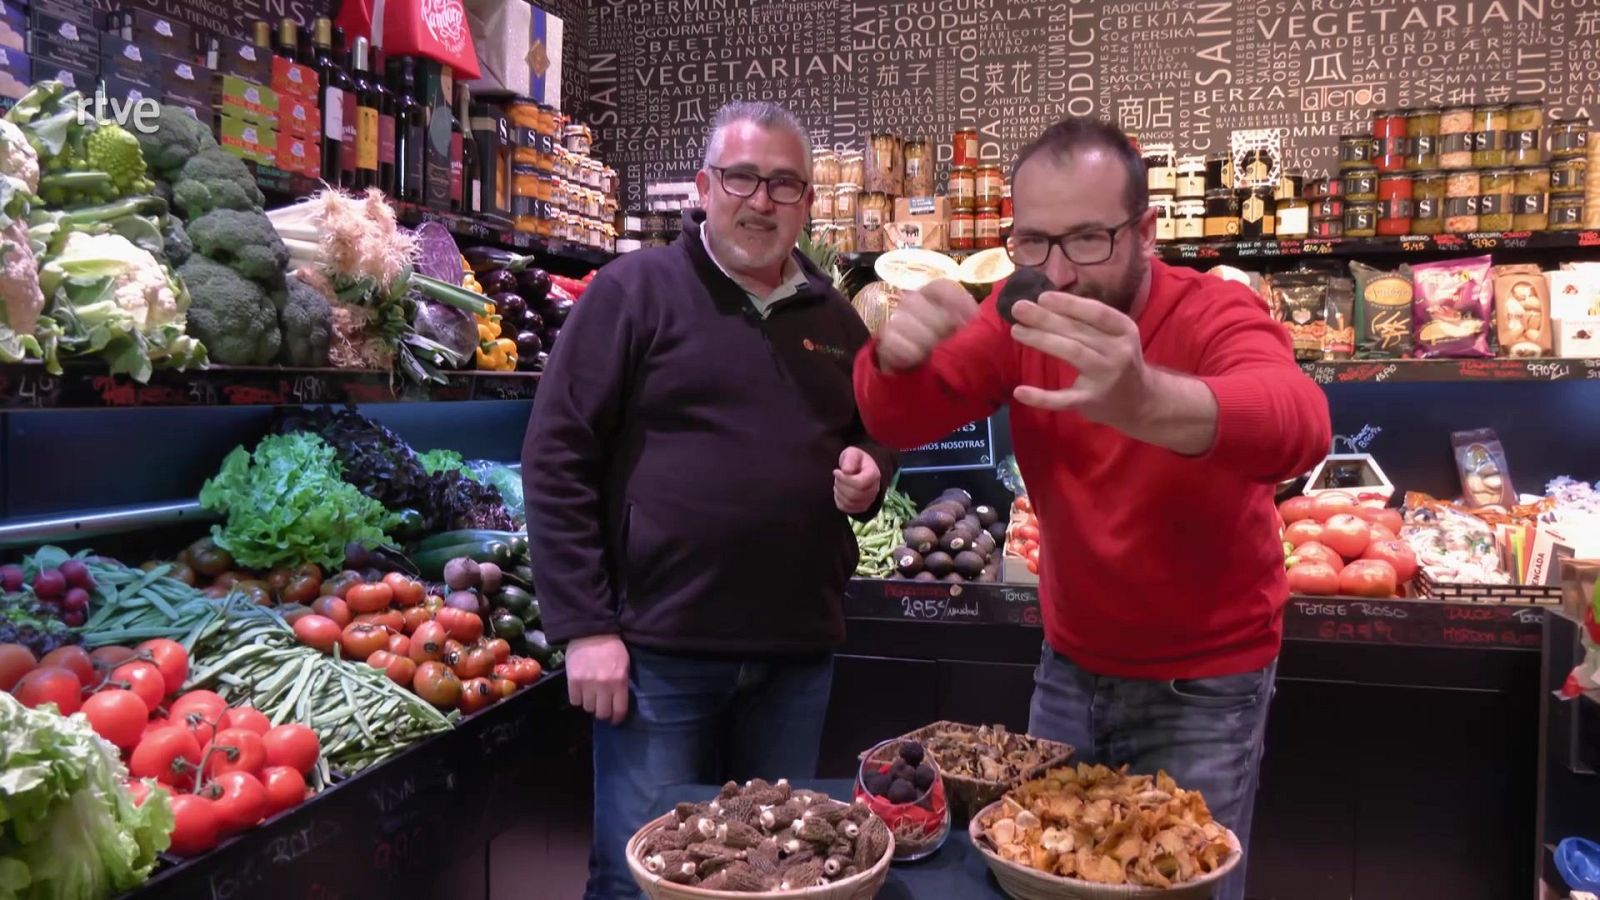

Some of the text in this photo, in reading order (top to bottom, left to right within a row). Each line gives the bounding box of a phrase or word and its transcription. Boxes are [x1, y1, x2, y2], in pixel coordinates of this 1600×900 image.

[670, 7, 761, 23] VERDURE
[789, 0, 840, 13] BRESKVE
[979, 6, 1046, 24] SALAT
[184, 8, 232, 36] TIENDA
[852, 2, 876, 51] EAT
[879, 13, 960, 34] FOOD
[1257, 0, 1545, 40] VEGETARIAN
[645, 21, 724, 39] GOURMET
[877, 29, 961, 50] GARLIC
[1131, 27, 1196, 42] PERSIKA
[634, 17, 646, 67] OVOCE
[649, 36, 719, 53] BEET
[1194, 2, 1232, 85] SAIN
[1290, 31, 1416, 51] AARDBEIEN
[1367, 38, 1500, 59] JORDBÆR
[1047, 3, 1066, 103] CUCUMBERS
[1109, 31, 1119, 73] ALHO
[1120, 34, 1129, 73] PERA
[1548, 11, 1565, 106] LECHUGAS
[635, 52, 853, 86] VEGETARIAN
[1272, 42, 1287, 82] OBST
[1113, 80, 1177, 93] SALATA
[1446, 70, 1516, 85] MAIZE
[588, 52, 619, 125] SAIN
[661, 81, 757, 99] AARDBEIEN
[719, 87, 820, 104] JORDBÆR
[871, 86, 933, 99] SALATA
[1194, 85, 1286, 104] BERZA
[648, 87, 660, 124] OBST
[871, 97, 934, 108] UBORKA
[872, 105, 933, 118] WORTEL
[977, 103, 1065, 118] POMPOEN
[1117, 92, 1175, 130] 商店
[1219, 101, 1286, 113] KALBAZA
[1179, 79, 1191, 150] KAROTTE
[671, 124, 710, 136] MELO
[833, 95, 857, 157] RUIT
[1279, 125, 1341, 138] OMME
[615, 136, 710, 152] EGGPLAN
[1139, 131, 1175, 142] ANGOS
[644, 160, 700, 173] POMME
[627, 164, 641, 202] SOLER
[940, 439, 985, 451] NOSOTRAS
